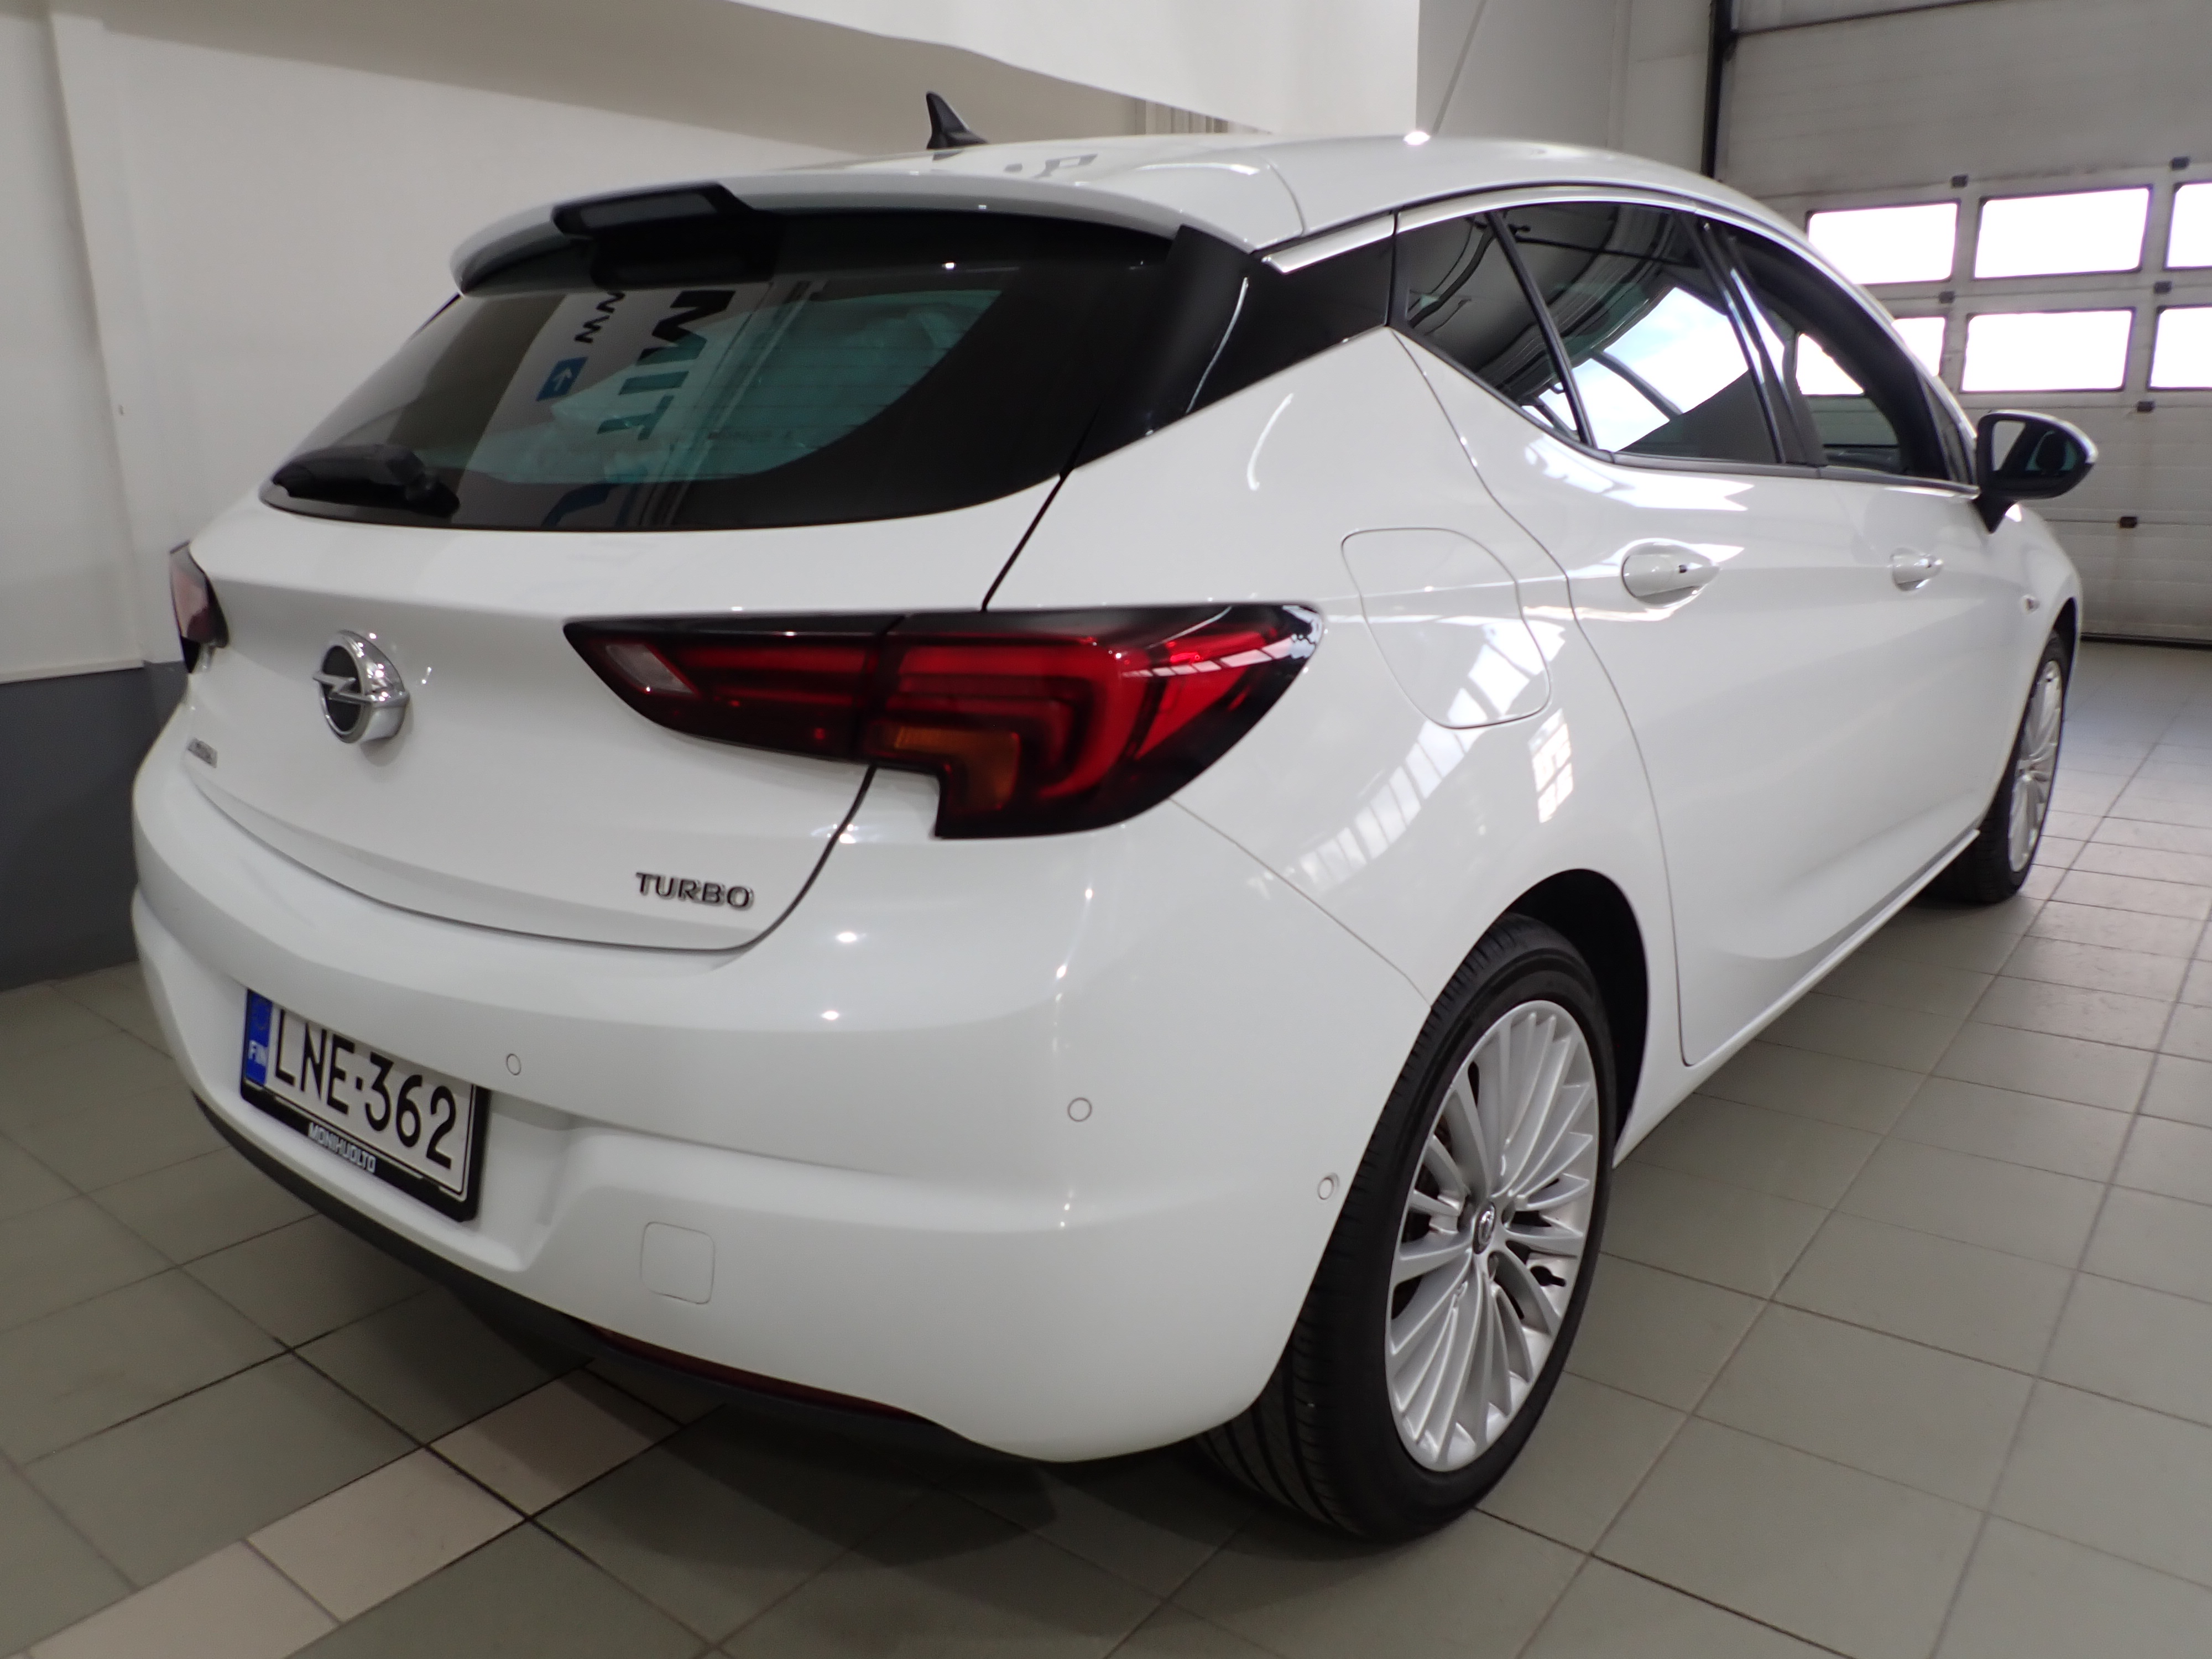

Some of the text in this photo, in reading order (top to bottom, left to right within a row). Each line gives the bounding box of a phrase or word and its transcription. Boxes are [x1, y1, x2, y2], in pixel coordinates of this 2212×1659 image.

[636, 872, 754, 910] TURBO
[248, 1040, 267, 1066] FIN
[275, 1009, 457, 1170] LNE-362
[308, 1122, 376, 1173] MONIHUOLTO
